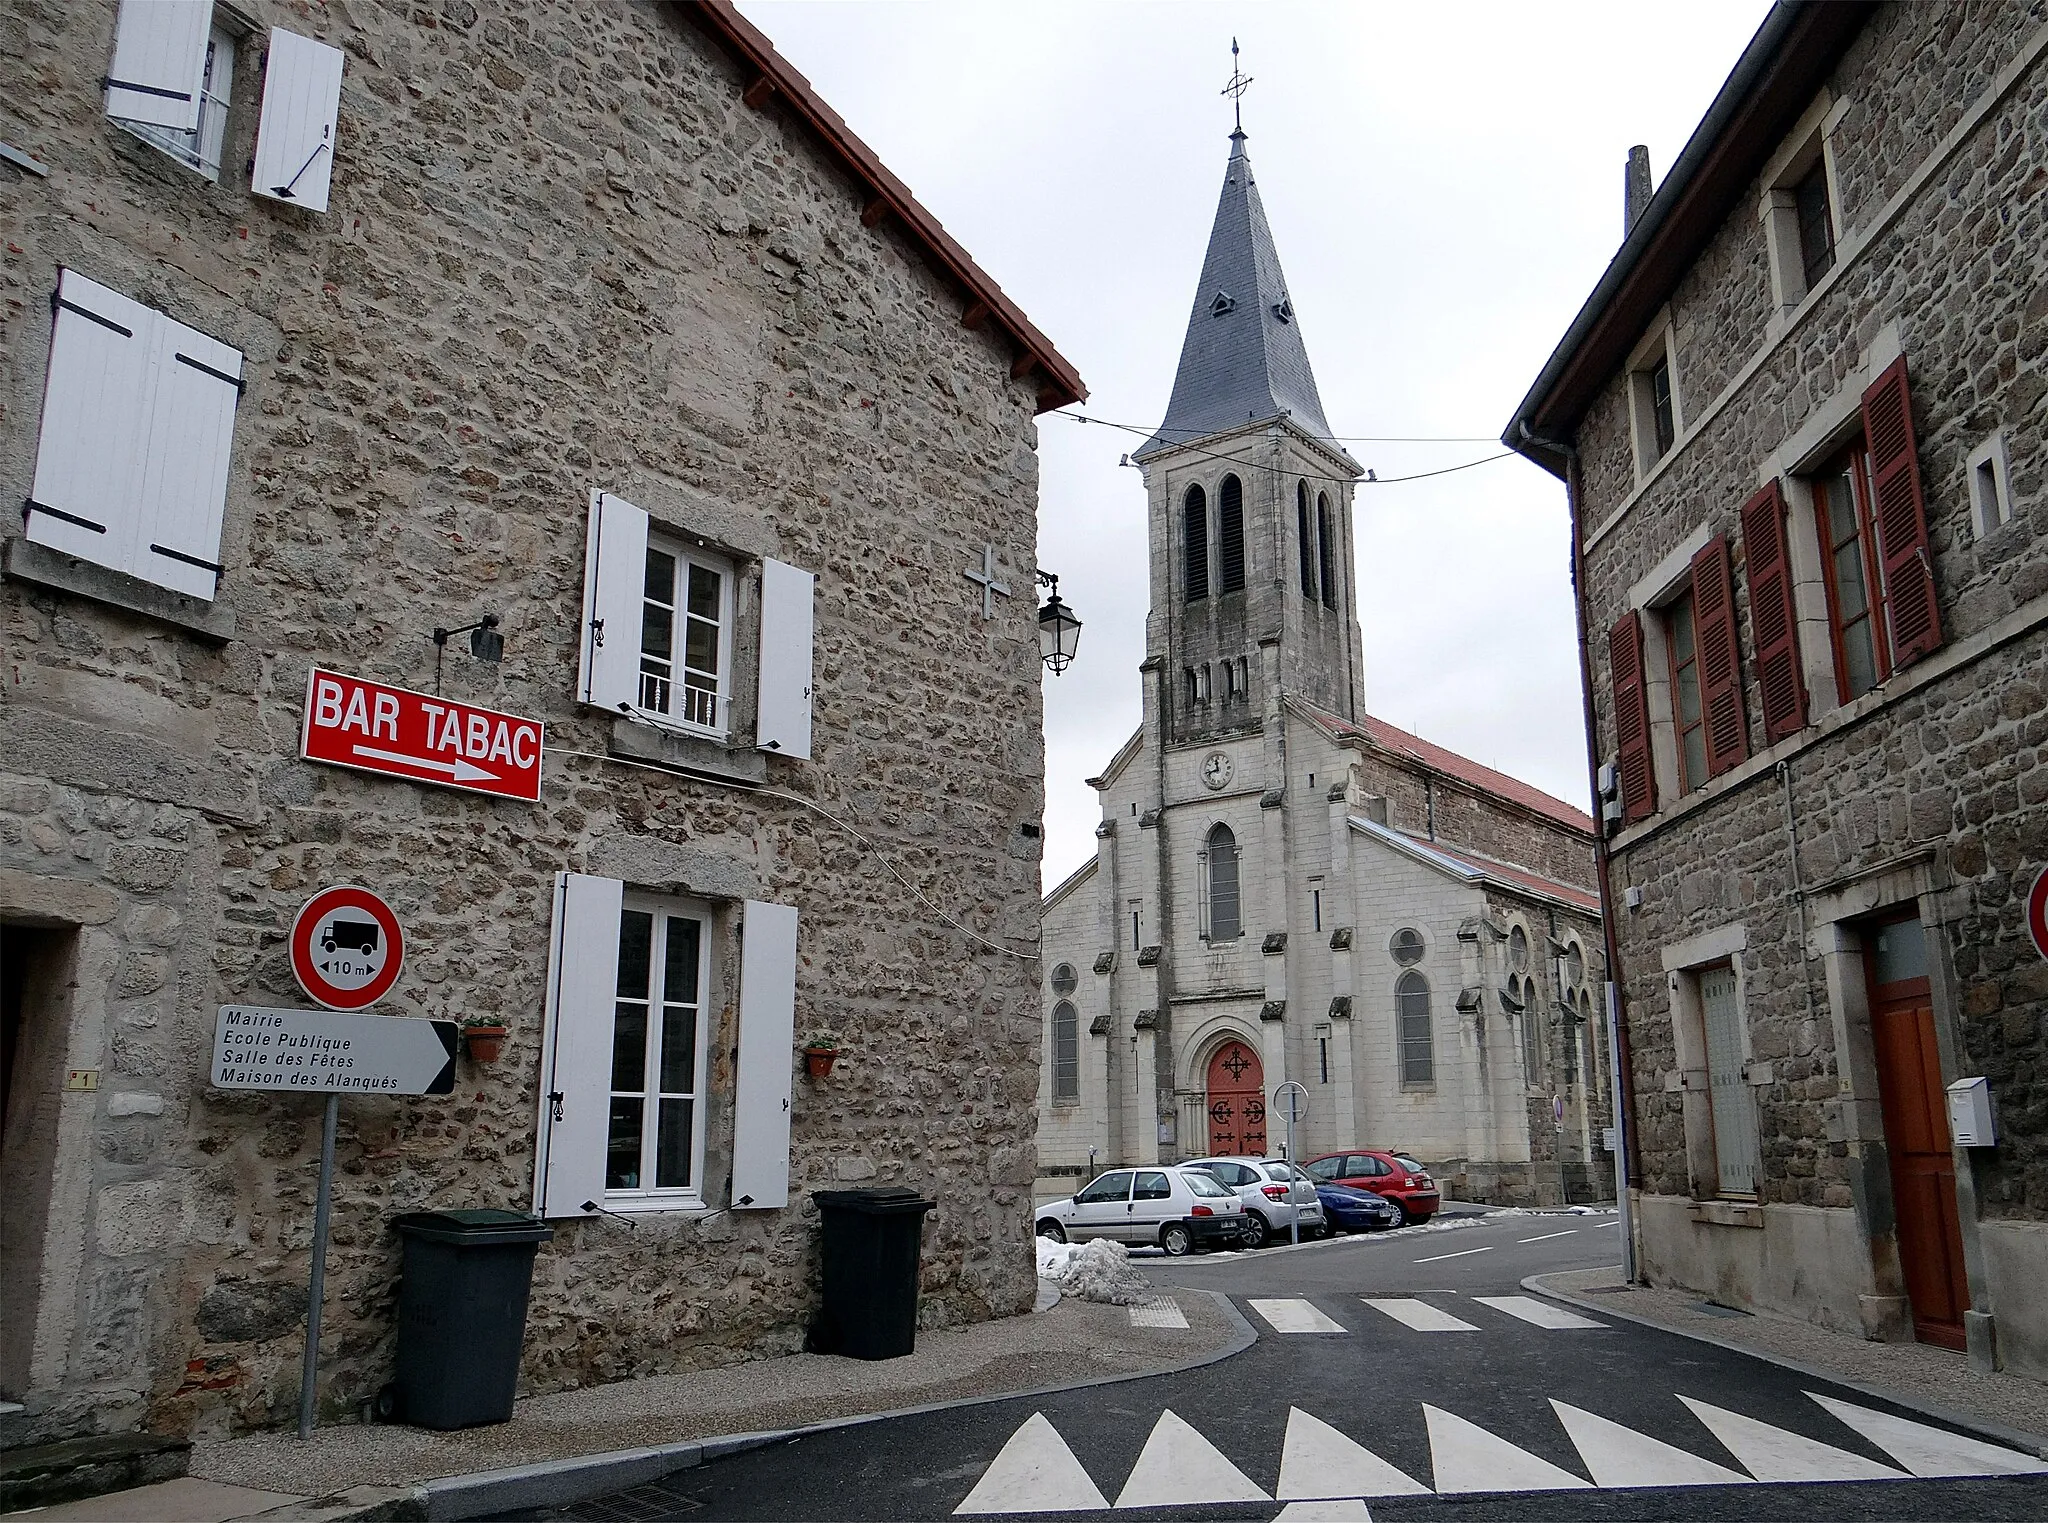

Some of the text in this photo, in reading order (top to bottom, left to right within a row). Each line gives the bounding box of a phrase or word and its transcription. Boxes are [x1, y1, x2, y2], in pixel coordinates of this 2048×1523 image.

[314, 678, 536, 770] BAR TABAC
[333, 961, 365, 976] 10 m
[226, 1011, 283, 1028] Mairie
[223, 1031, 351, 1053] Ecole Publique
[222, 1050, 354, 1068] Salle des Fêtes
[83, 1073, 89, 1087] 1
[220, 1068, 398, 1091] Maison des Alanqués
